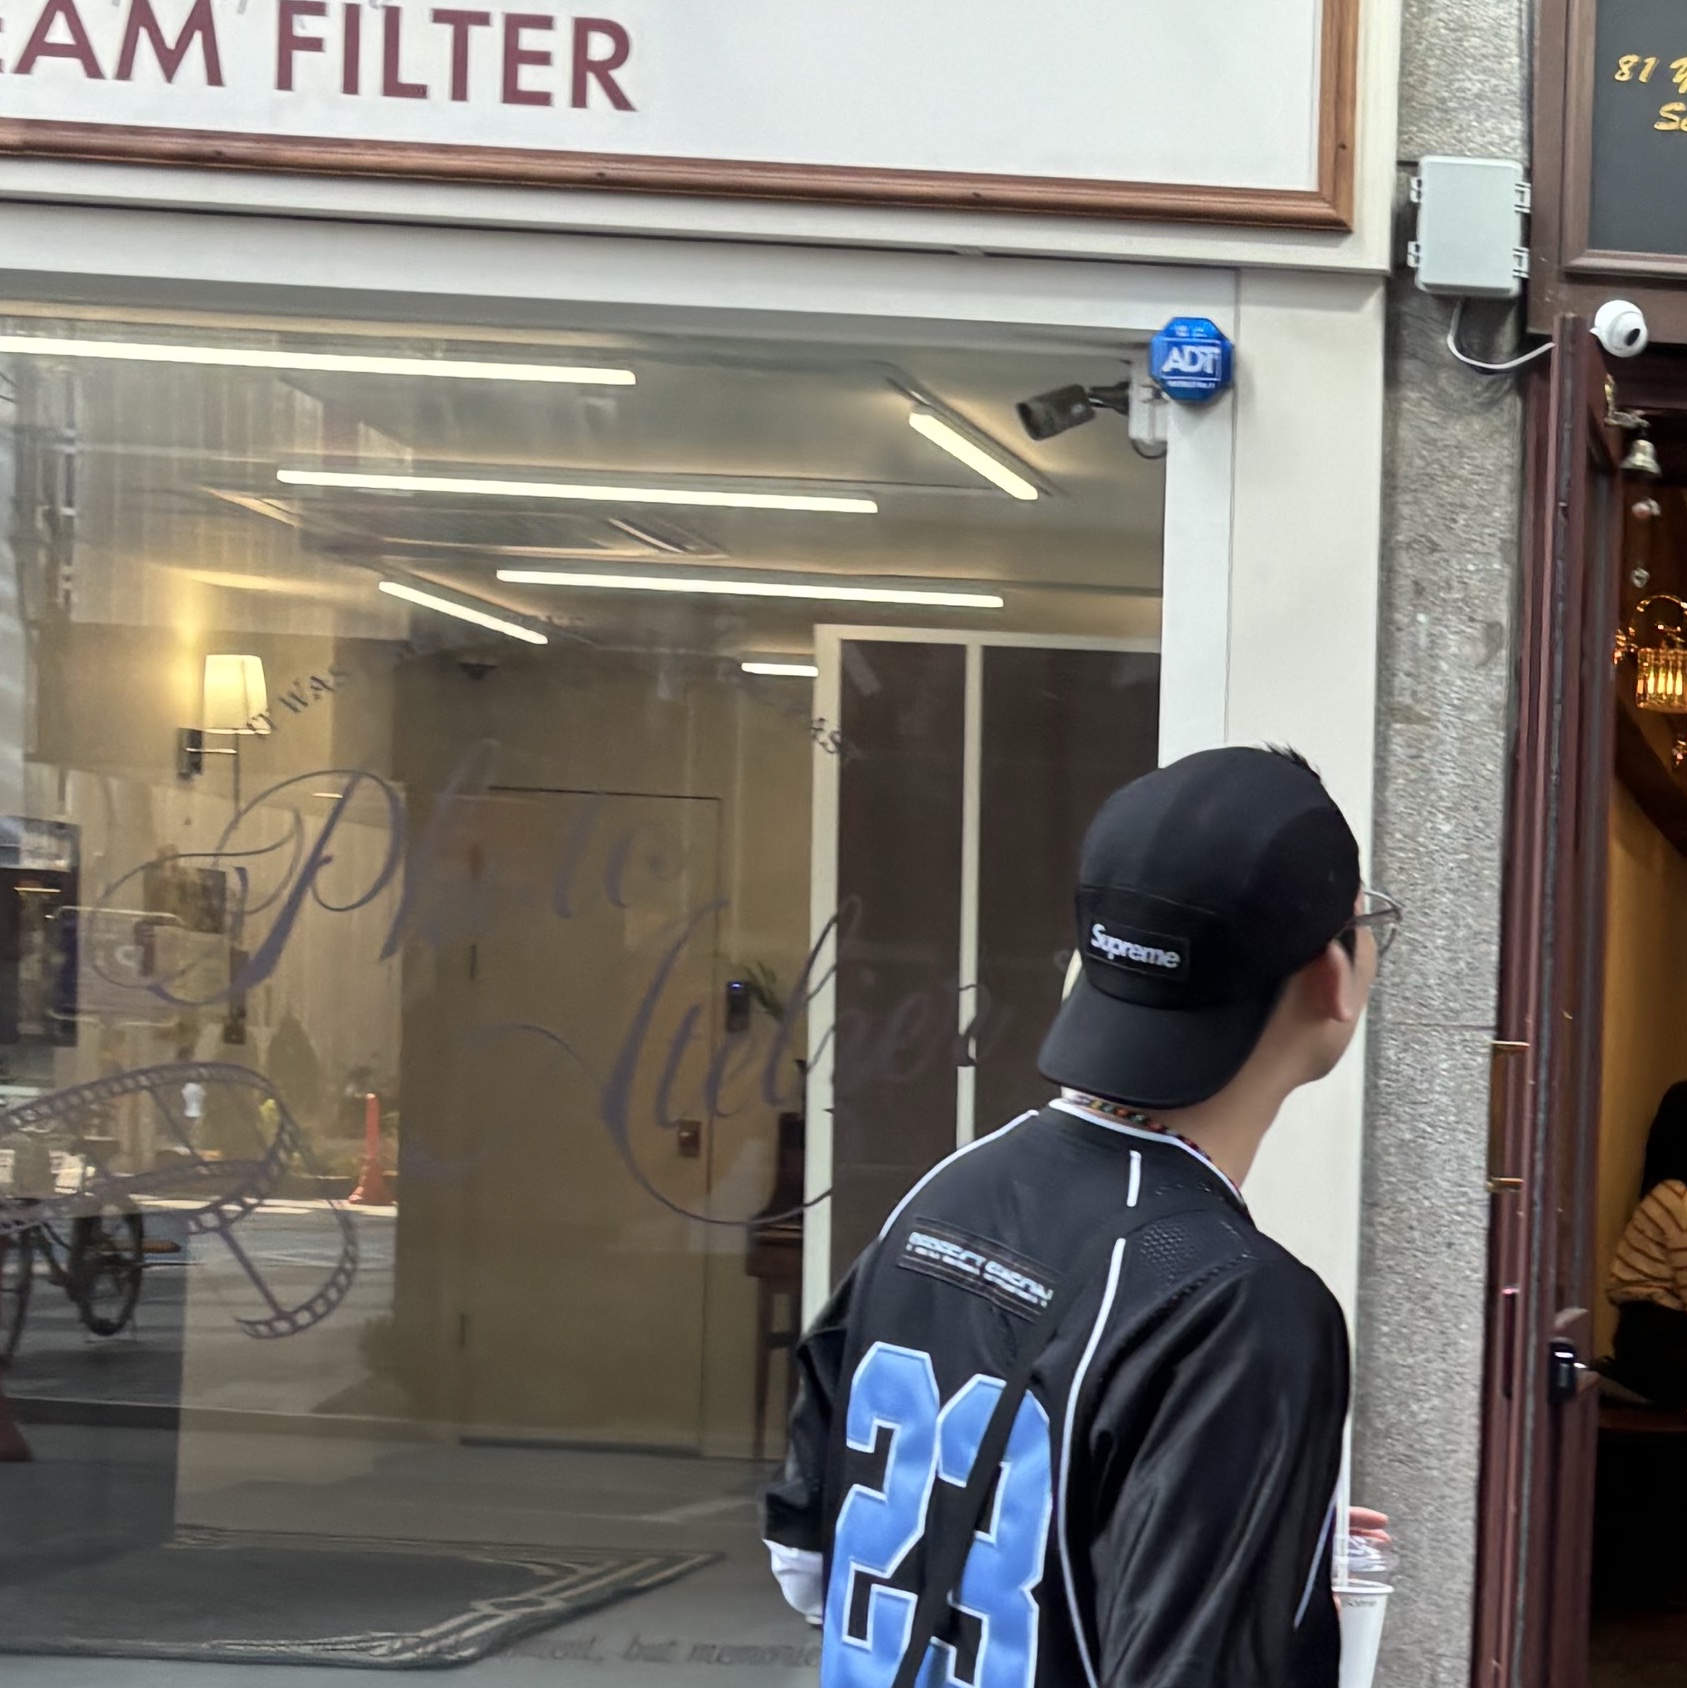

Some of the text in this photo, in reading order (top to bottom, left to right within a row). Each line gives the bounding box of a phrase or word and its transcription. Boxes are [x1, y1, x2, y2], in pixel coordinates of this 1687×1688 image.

[0, 0, 638, 112] AM FILTER
[1613, 54, 1659, 83] 81
[1161, 344, 1222, 375] ADT
[1090, 923, 1181, 969] Supreme
